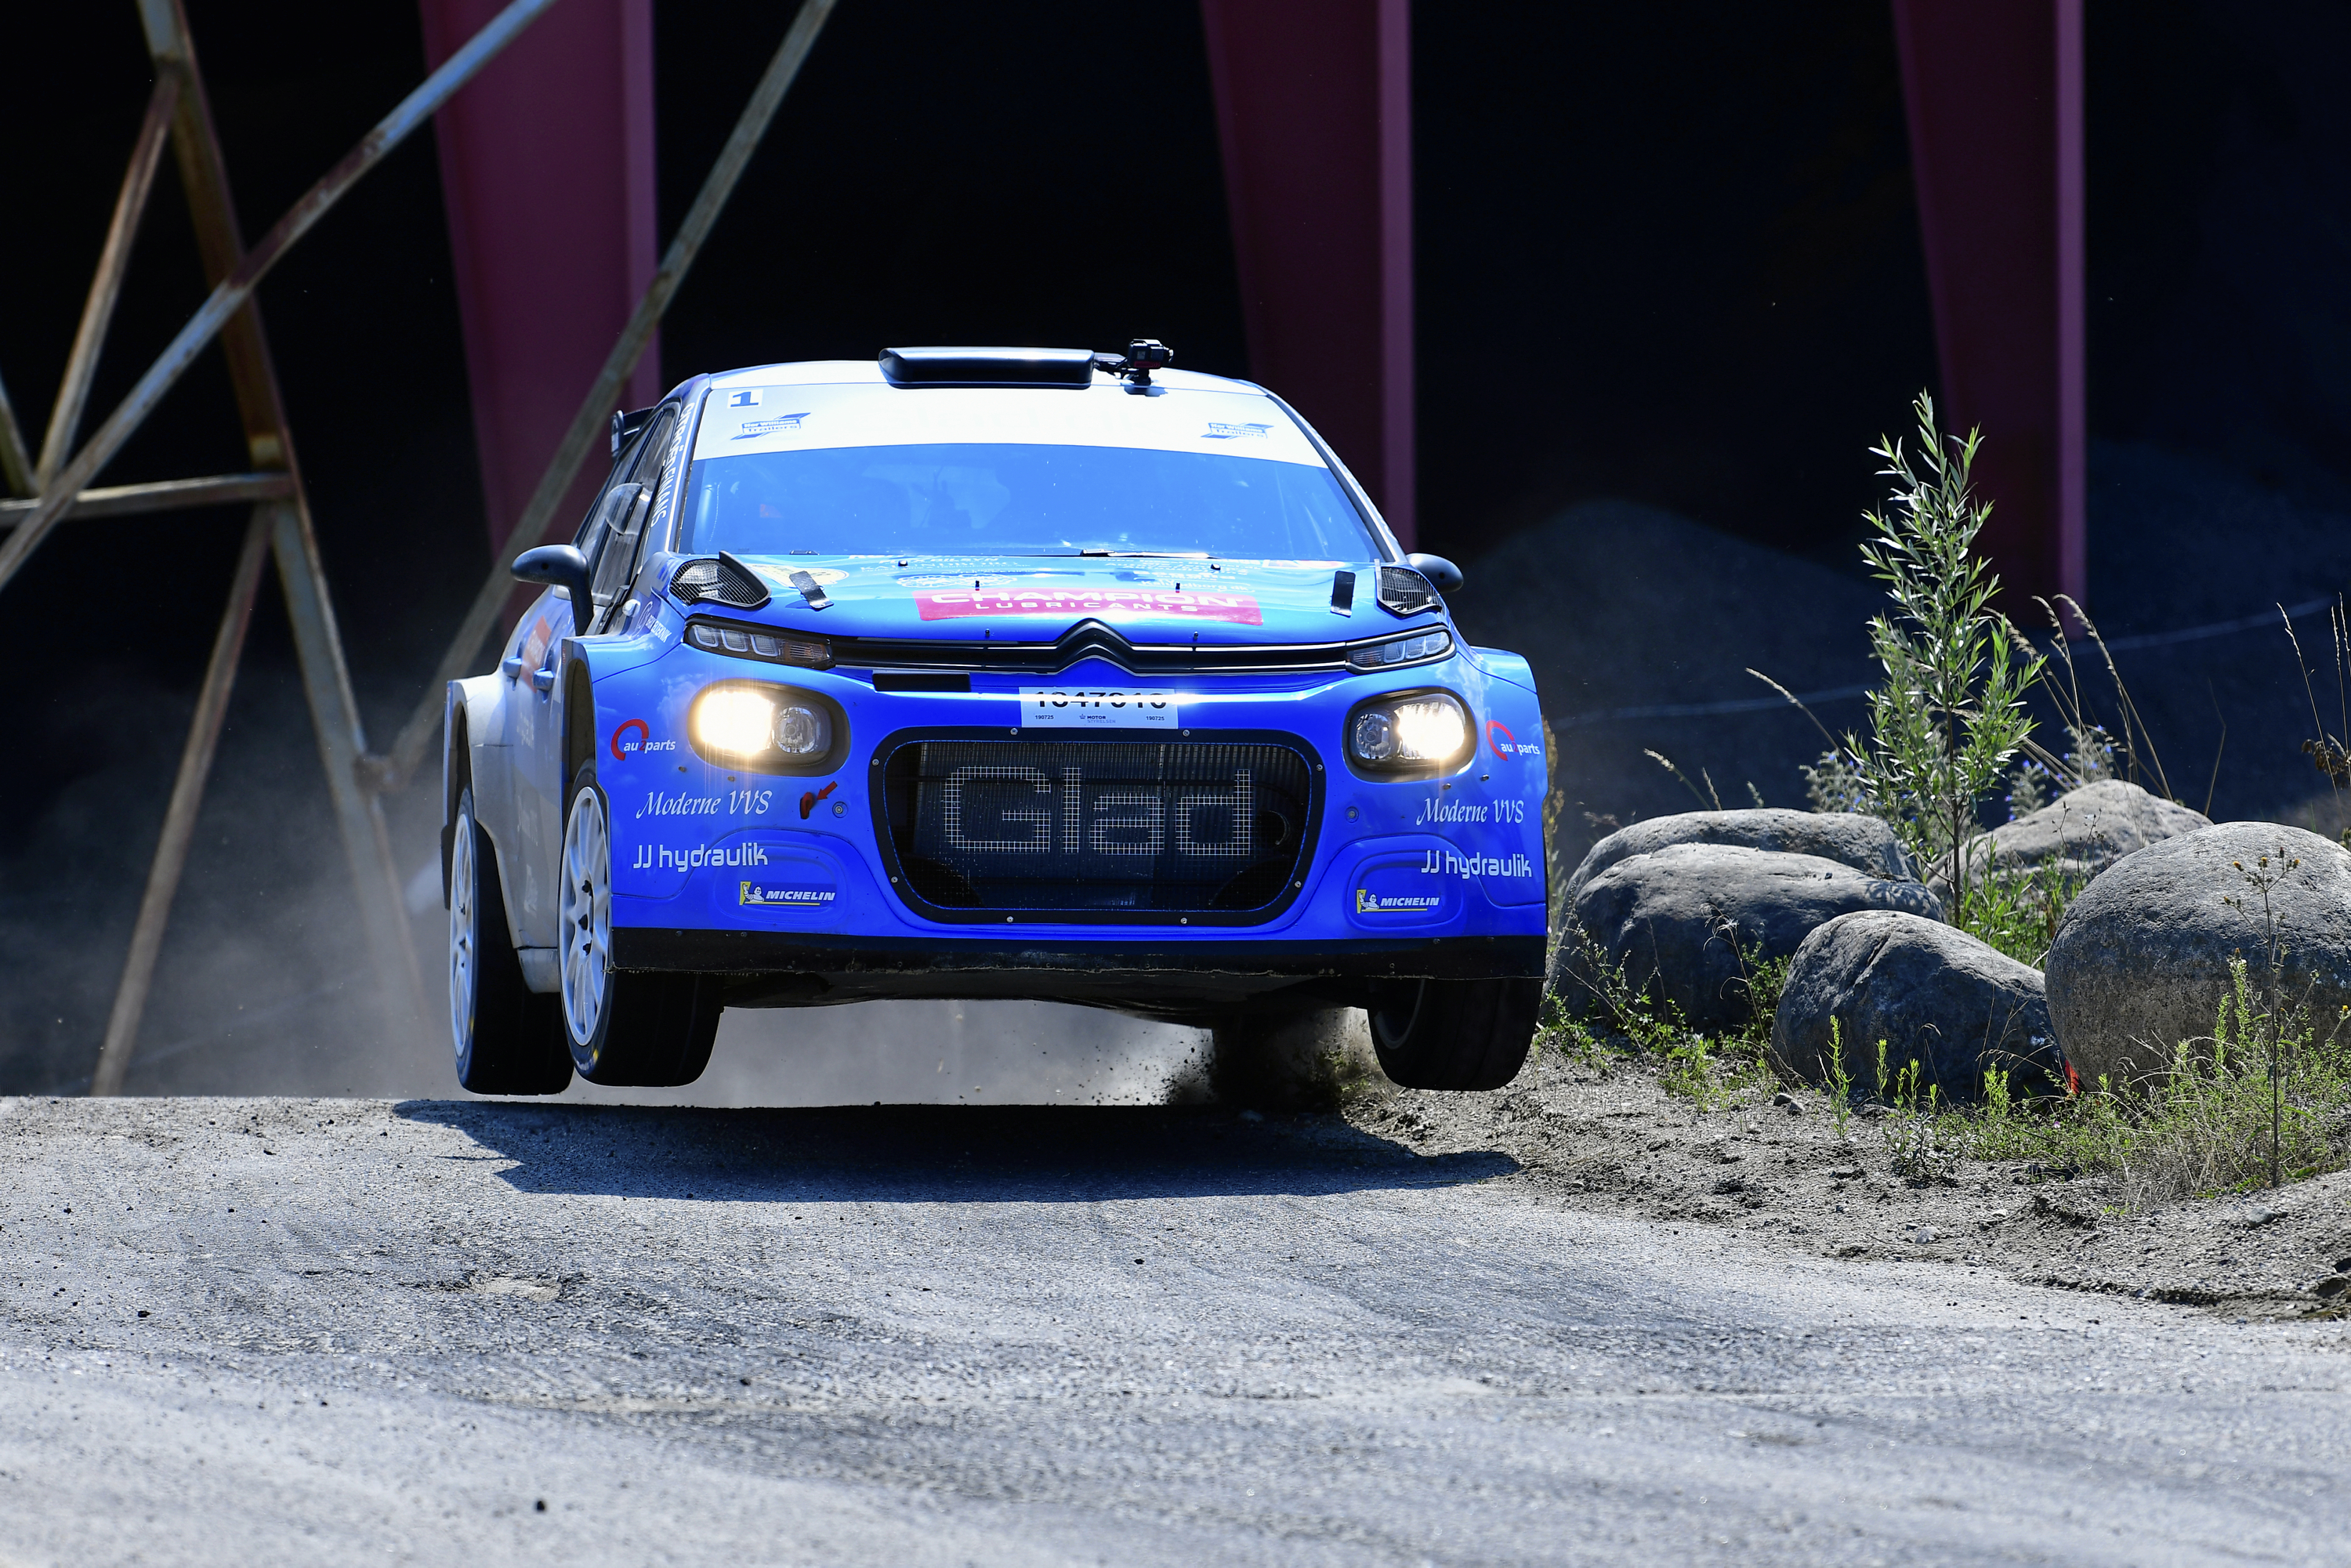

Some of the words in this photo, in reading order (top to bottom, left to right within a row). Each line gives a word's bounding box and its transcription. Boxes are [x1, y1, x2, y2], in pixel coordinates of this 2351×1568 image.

[730, 391, 759, 407] 1
[650, 467, 676, 527] FINANS
[931, 591, 1238, 608] CHAMPION
[976, 601, 1198, 612] LUBRICANTS
[624, 740, 676, 754] au2parts
[1501, 741, 1541, 756] au2parts
[636, 791, 722, 819] Moderne
[728, 790, 773, 815] VVS
[944, 766, 1252, 856] Glad
[1416, 798, 1487, 825] Moderne
[1492, 799, 1524, 824] VVS
[633, 845, 652, 868] JJ
[659, 842, 769, 872] hydraulik
[1421, 850, 1440, 874] JJ
[1446, 850, 1532, 879] hydraulik
[765, 890, 837, 901] MICHELIN
[1380, 897, 1440, 907] MICHELIN
